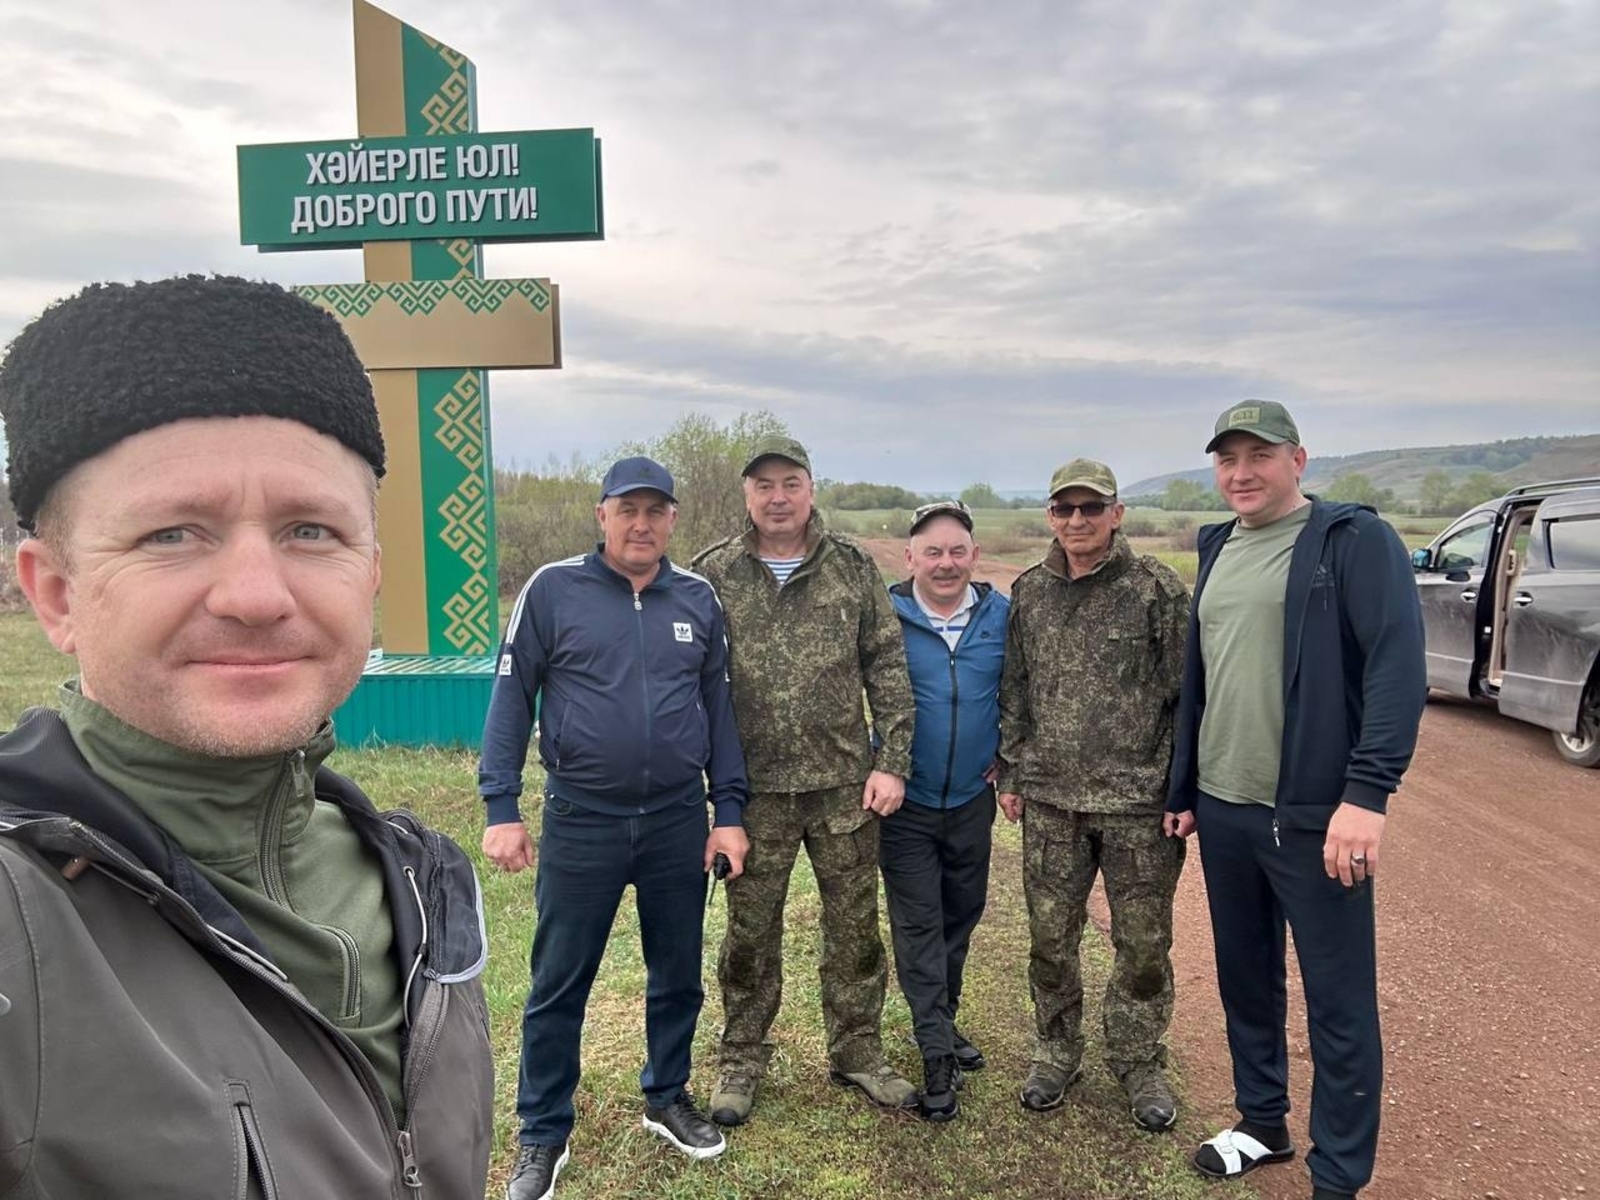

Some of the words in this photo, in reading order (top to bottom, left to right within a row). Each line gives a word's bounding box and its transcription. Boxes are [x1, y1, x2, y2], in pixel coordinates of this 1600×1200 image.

[306, 143, 447, 184] ХӘЙЕРЛЕ
[457, 144, 520, 178] ЮЛ!
[291, 190, 437, 234] ДОБРОГО
[446, 187, 538, 222] ПУТИ!
